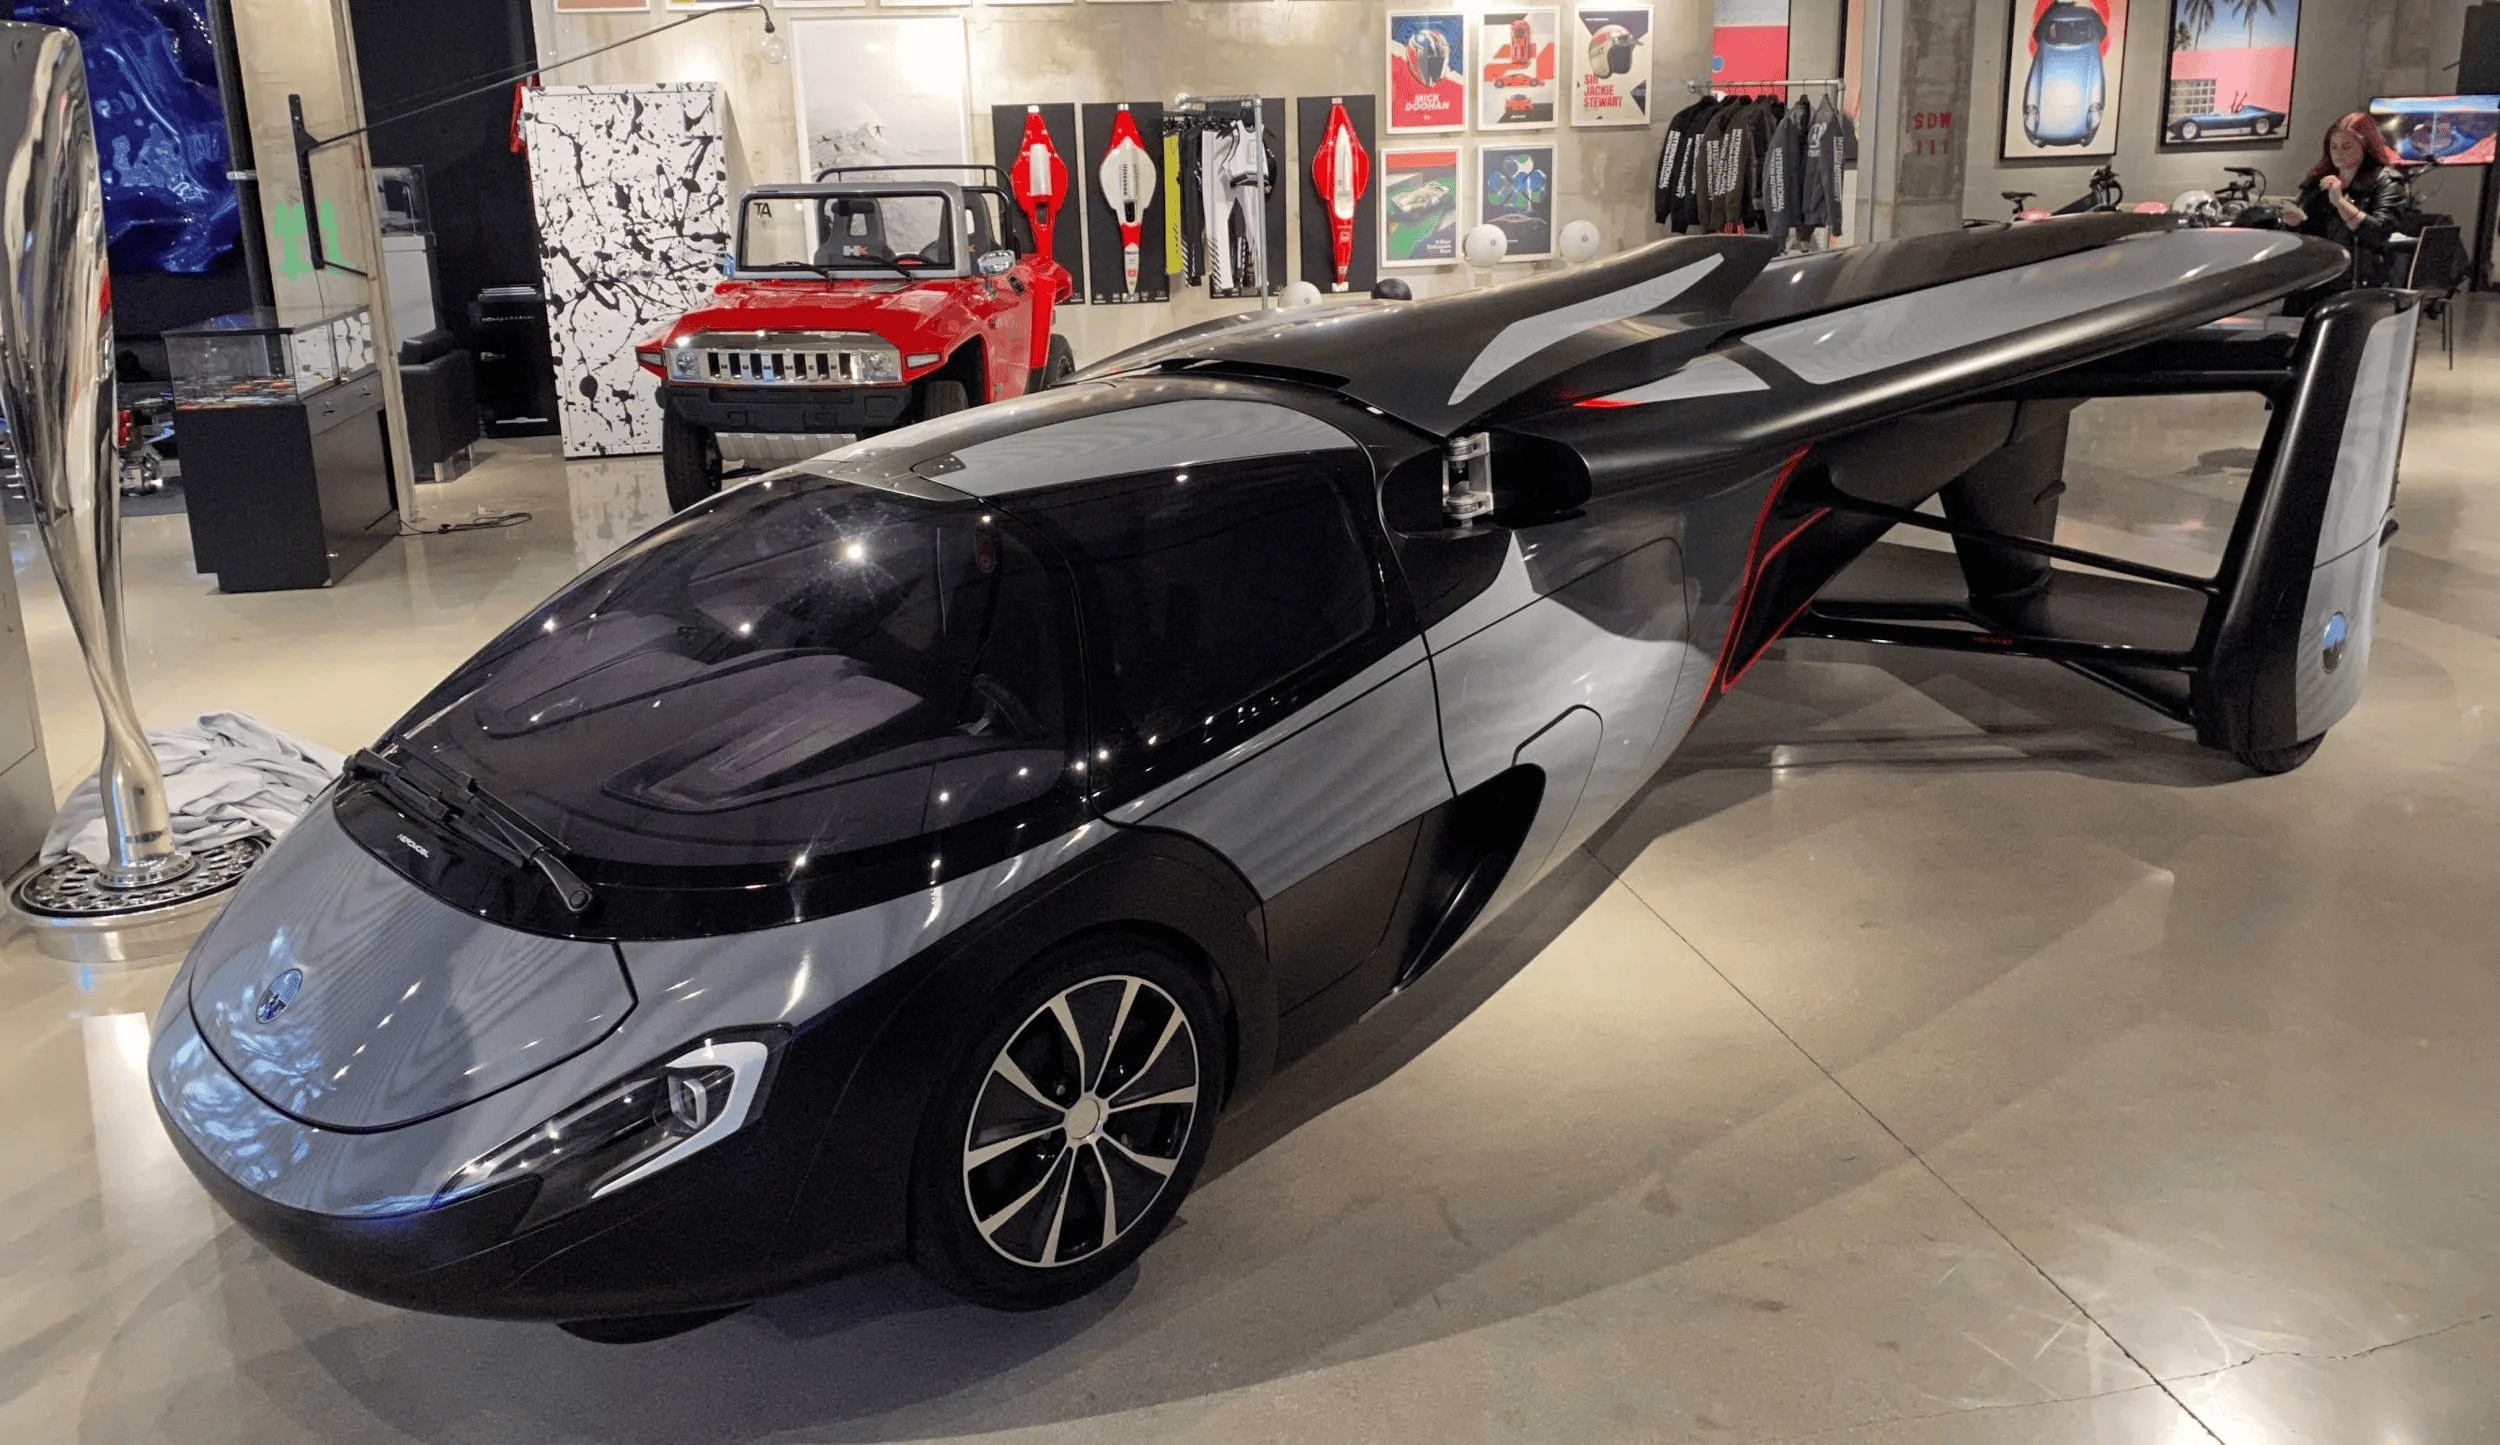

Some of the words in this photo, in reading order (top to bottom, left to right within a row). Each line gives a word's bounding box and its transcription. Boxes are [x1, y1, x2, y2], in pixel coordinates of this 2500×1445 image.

[1584, 73, 1598, 84] SIR
[1414, 93, 1440, 102] MICK
[1584, 85, 1614, 96] JACKIE
[1405, 101, 1450, 112] DOOHAN
[1584, 96, 1622, 108] STEWART
[1662, 131, 1681, 188] INTERNATIONAL
[1731, 129, 1743, 190] INTERNATIONAL
[1676, 163, 1686, 198] AUTHORITY
[1775, 147, 1784, 210] INTERNATIONAL
[753, 202, 772, 218] TA
